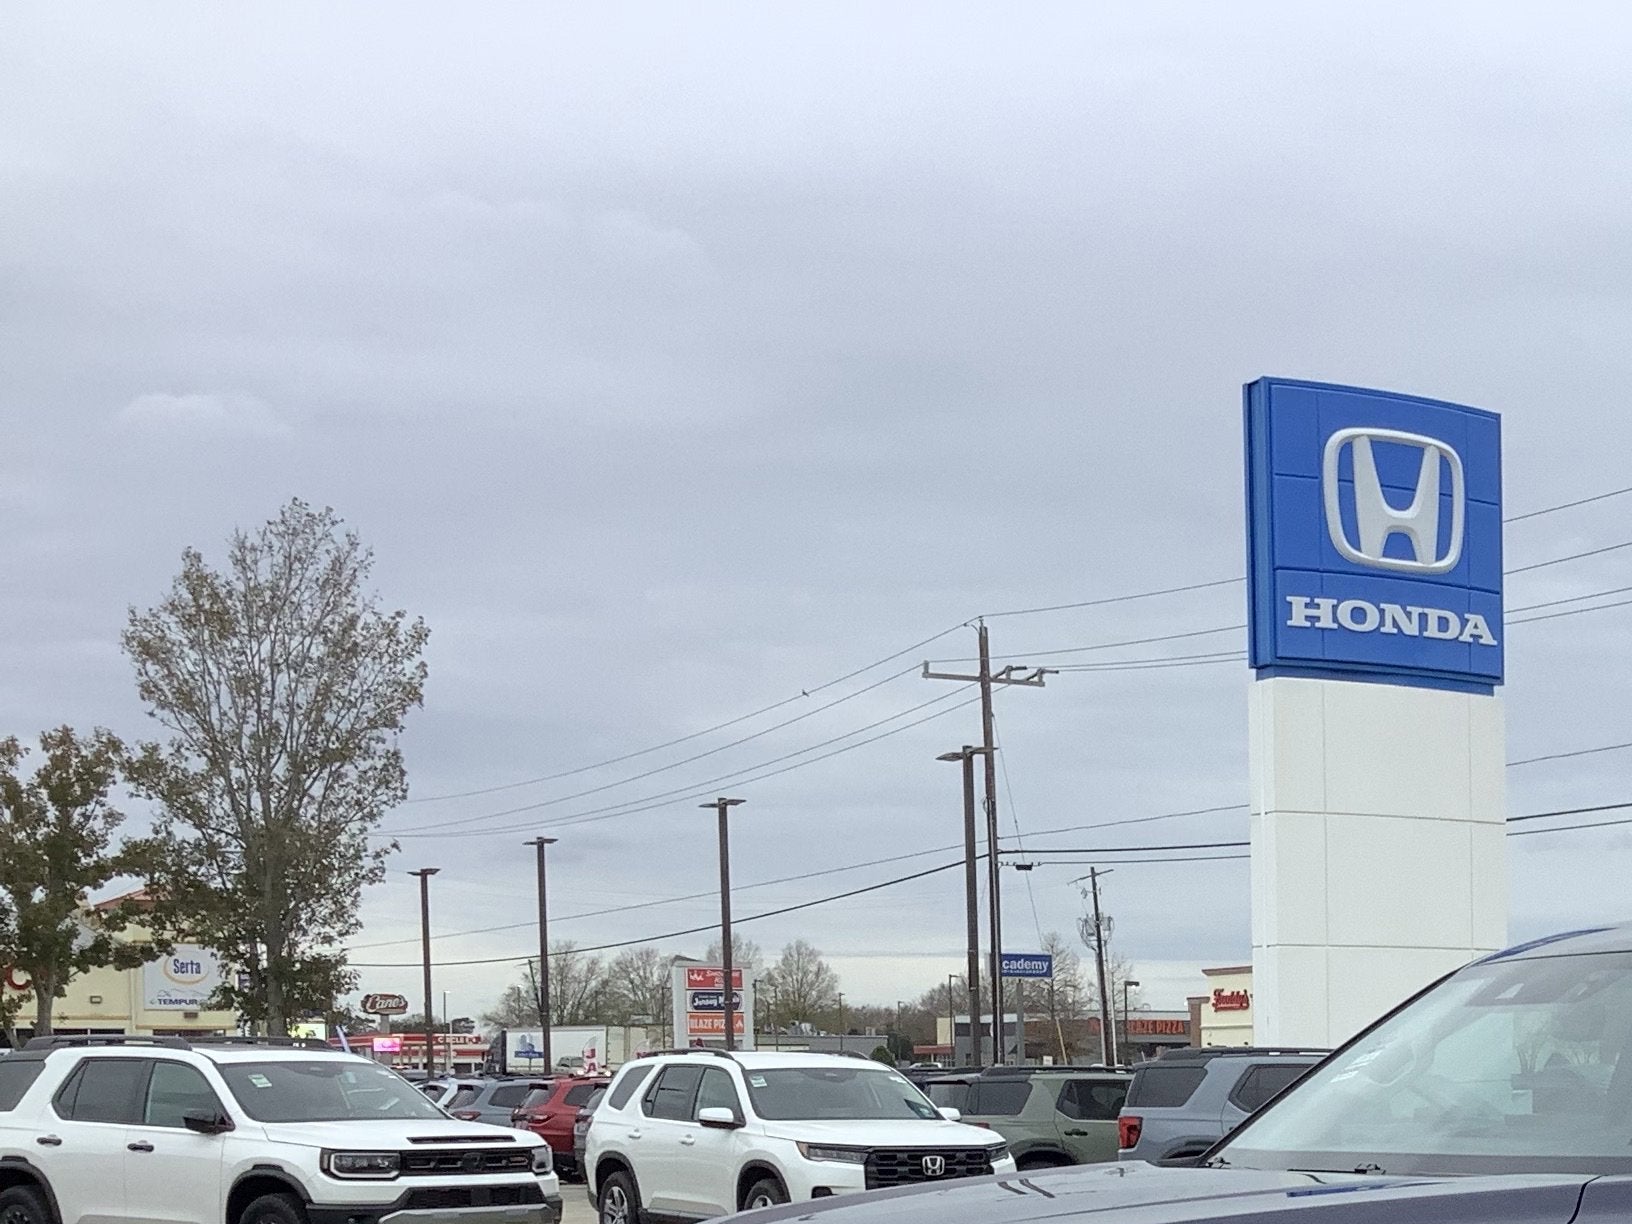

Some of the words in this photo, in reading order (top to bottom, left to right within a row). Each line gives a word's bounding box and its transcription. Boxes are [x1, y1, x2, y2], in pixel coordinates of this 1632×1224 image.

[1286, 596, 1498, 647] HONDA
[173, 958, 201, 974] Serta
[1156, 1020, 1184, 1034] PIZZA
